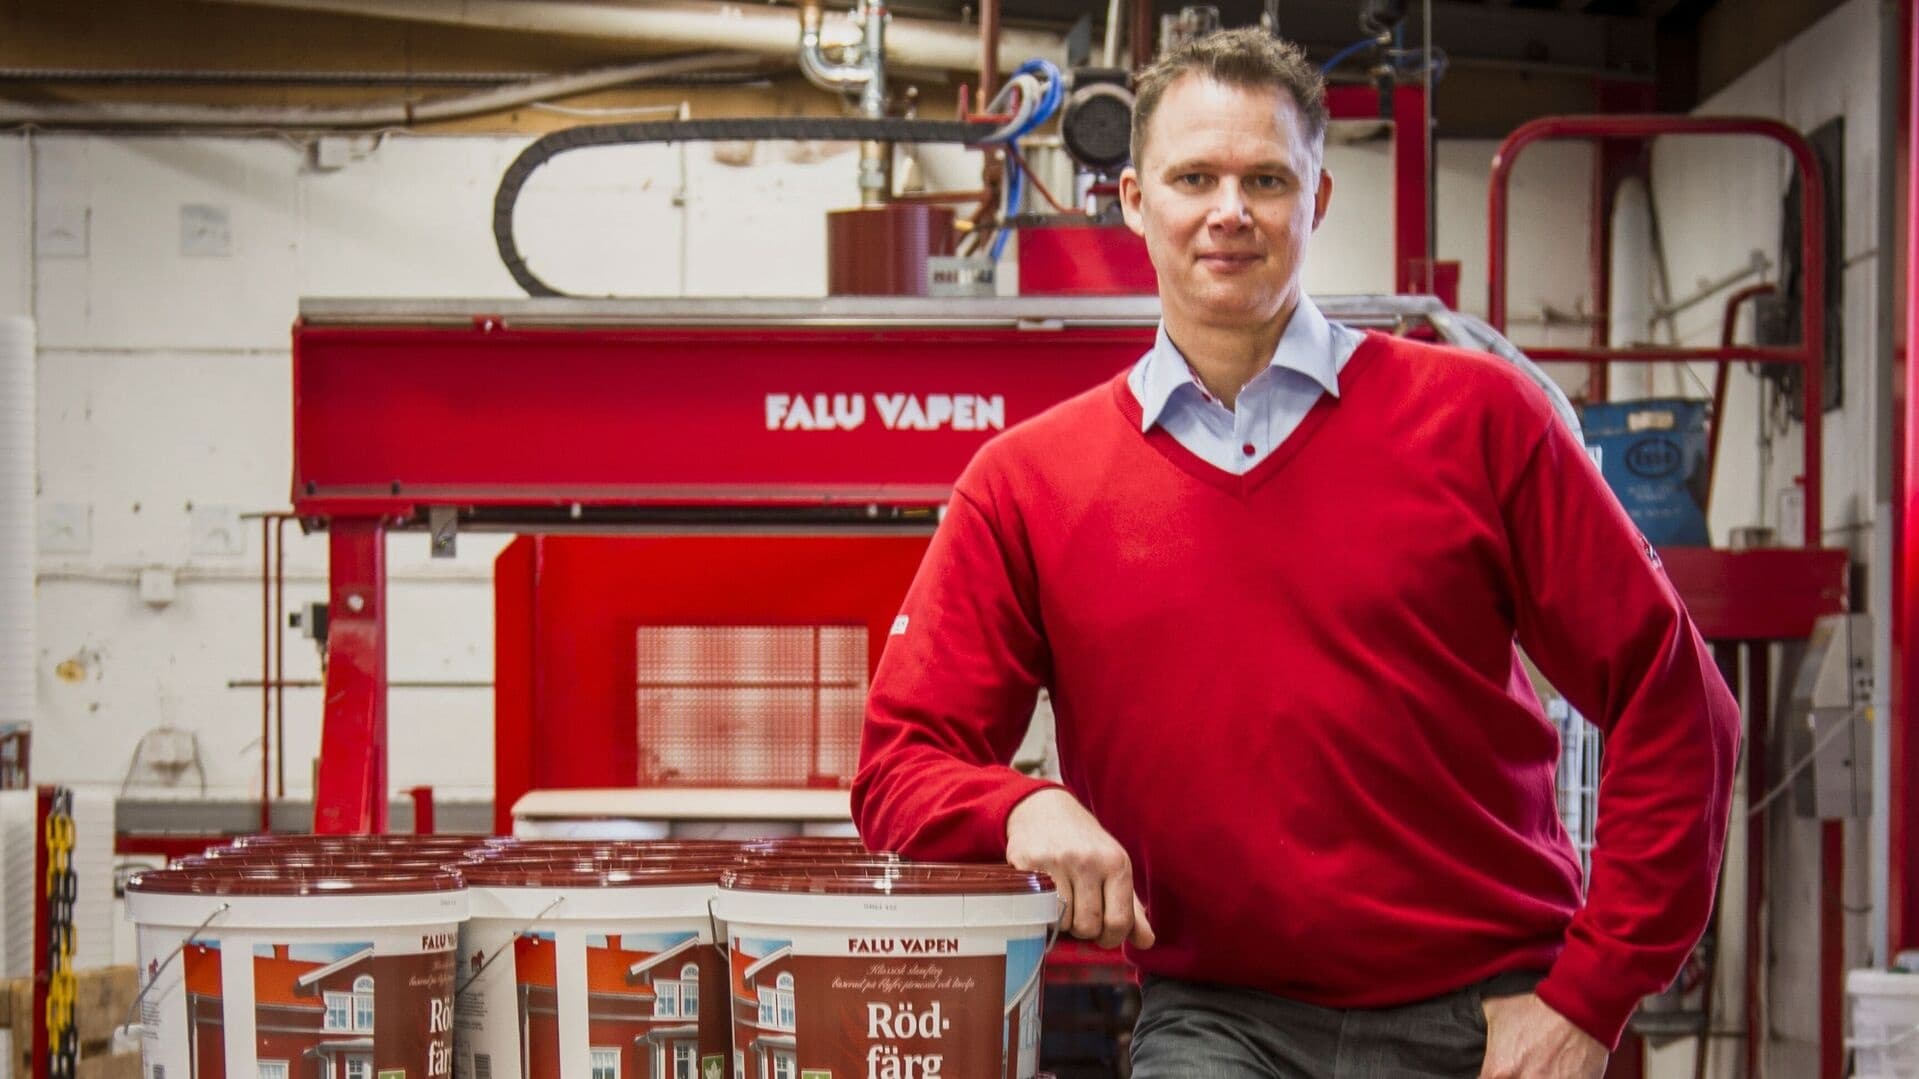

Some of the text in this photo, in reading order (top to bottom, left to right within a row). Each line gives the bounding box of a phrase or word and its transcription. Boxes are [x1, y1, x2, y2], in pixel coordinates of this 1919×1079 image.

[765, 393, 1005, 431] FALU VAPEN
[422, 933, 446, 949] FALU
[848, 938, 959, 953] FALU VAPEN
[866, 1044, 943, 1079] färg
